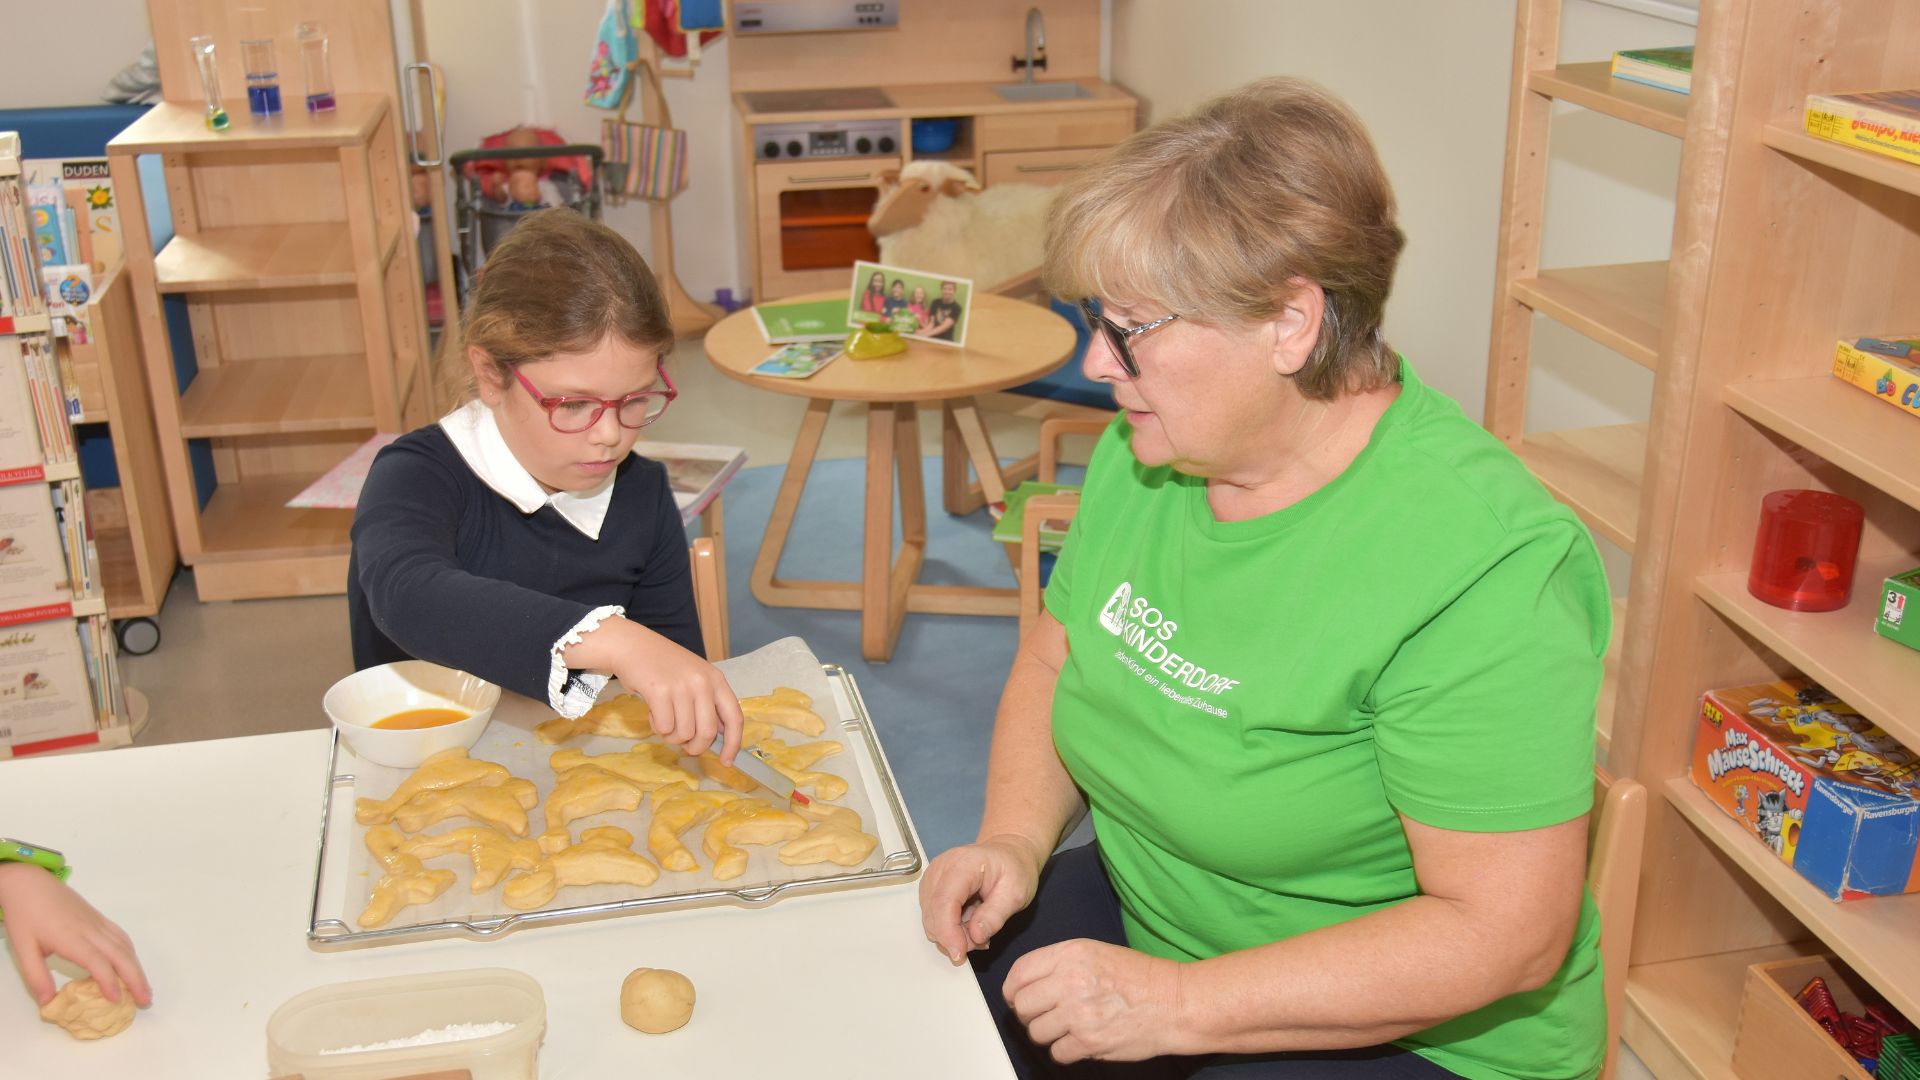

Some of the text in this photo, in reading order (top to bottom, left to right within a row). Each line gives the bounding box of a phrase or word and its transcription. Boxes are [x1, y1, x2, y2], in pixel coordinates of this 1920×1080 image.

[64, 164, 109, 177] DUDEN
[1888, 591, 1897, 603] 3
[1129, 597, 1178, 641] SOS
[1122, 619, 1241, 695] KINDERDORF
[1144, 674, 1160, 687] ein
[1191, 697, 1228, 719] Zuhause
[1725, 728, 1748, 748] Max
[1814, 780, 1854, 816] Ravensburger
[1832, 781, 1903, 801] Ravensburger
[1863, 805, 1919, 820] Ravensburger
